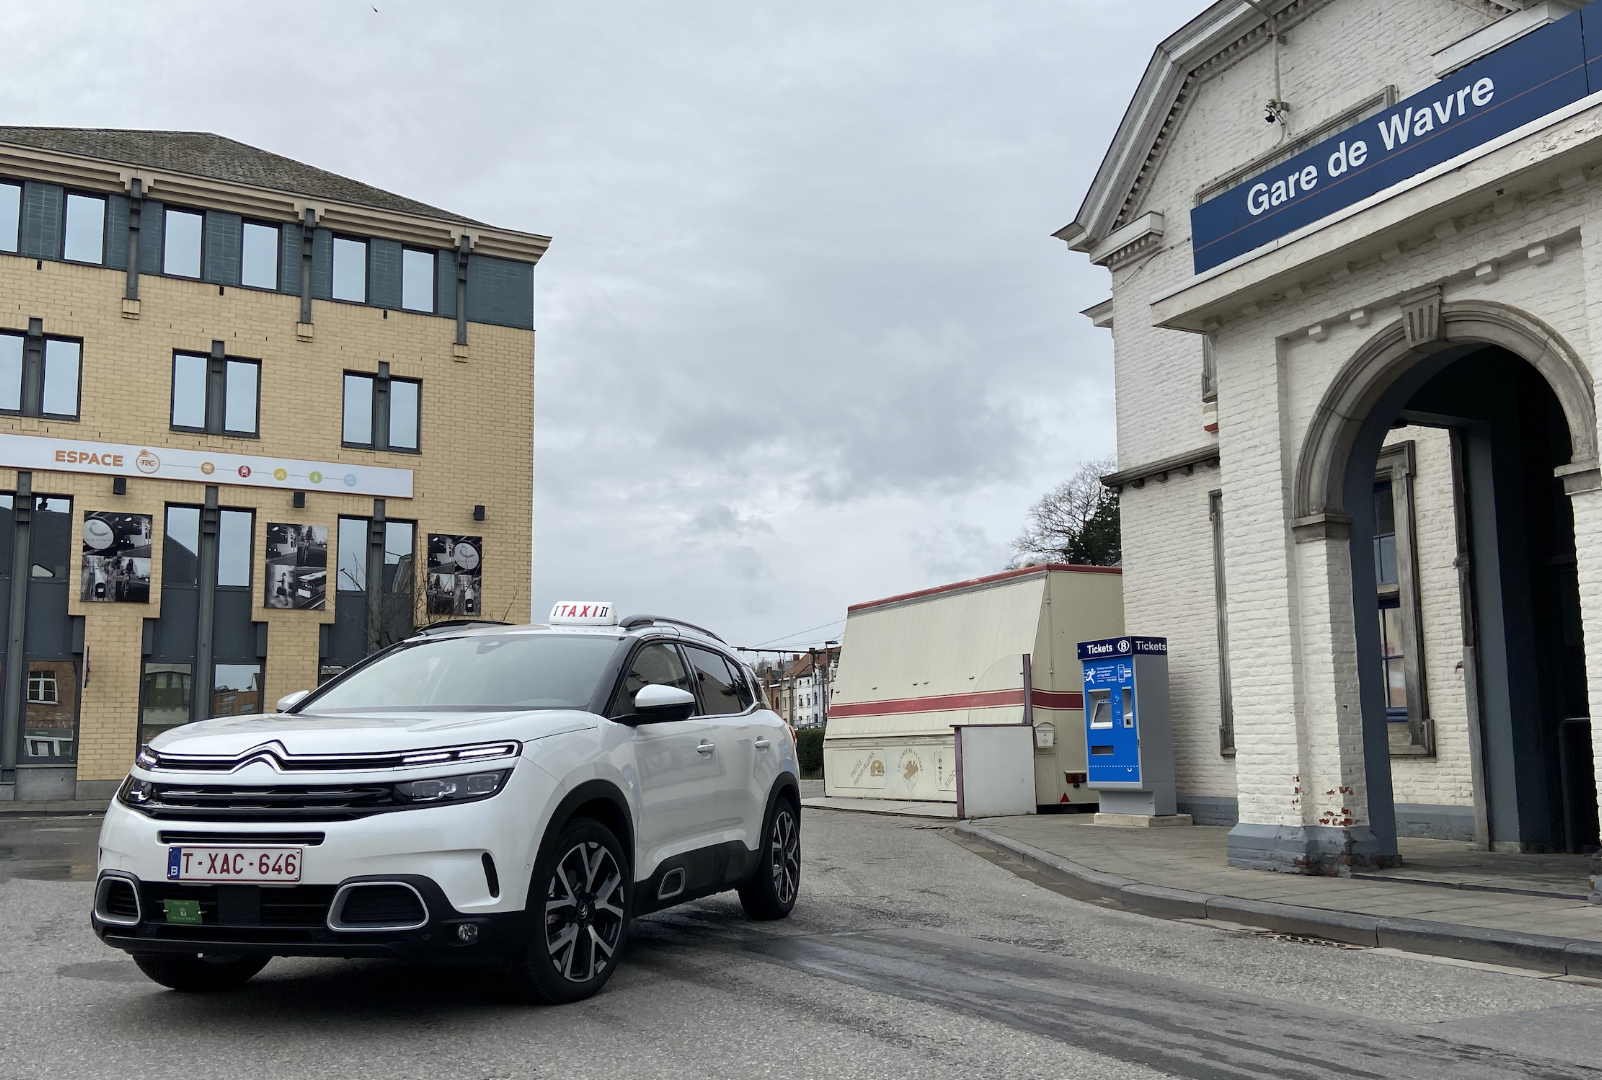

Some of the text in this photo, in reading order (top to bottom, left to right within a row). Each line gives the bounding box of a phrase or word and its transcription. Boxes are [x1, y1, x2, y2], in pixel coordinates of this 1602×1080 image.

[1247, 77, 1495, 217] Gare de Wavre
[55, 450, 155, 467] ESPACE TEC
[561, 605, 599, 617] TAXI
[1087, 643, 1113, 655] Tickets
[1135, 640, 1167, 651] Tickets
[182, 852, 297, 875] T-XAC-646
[170, 865, 178, 876] B
